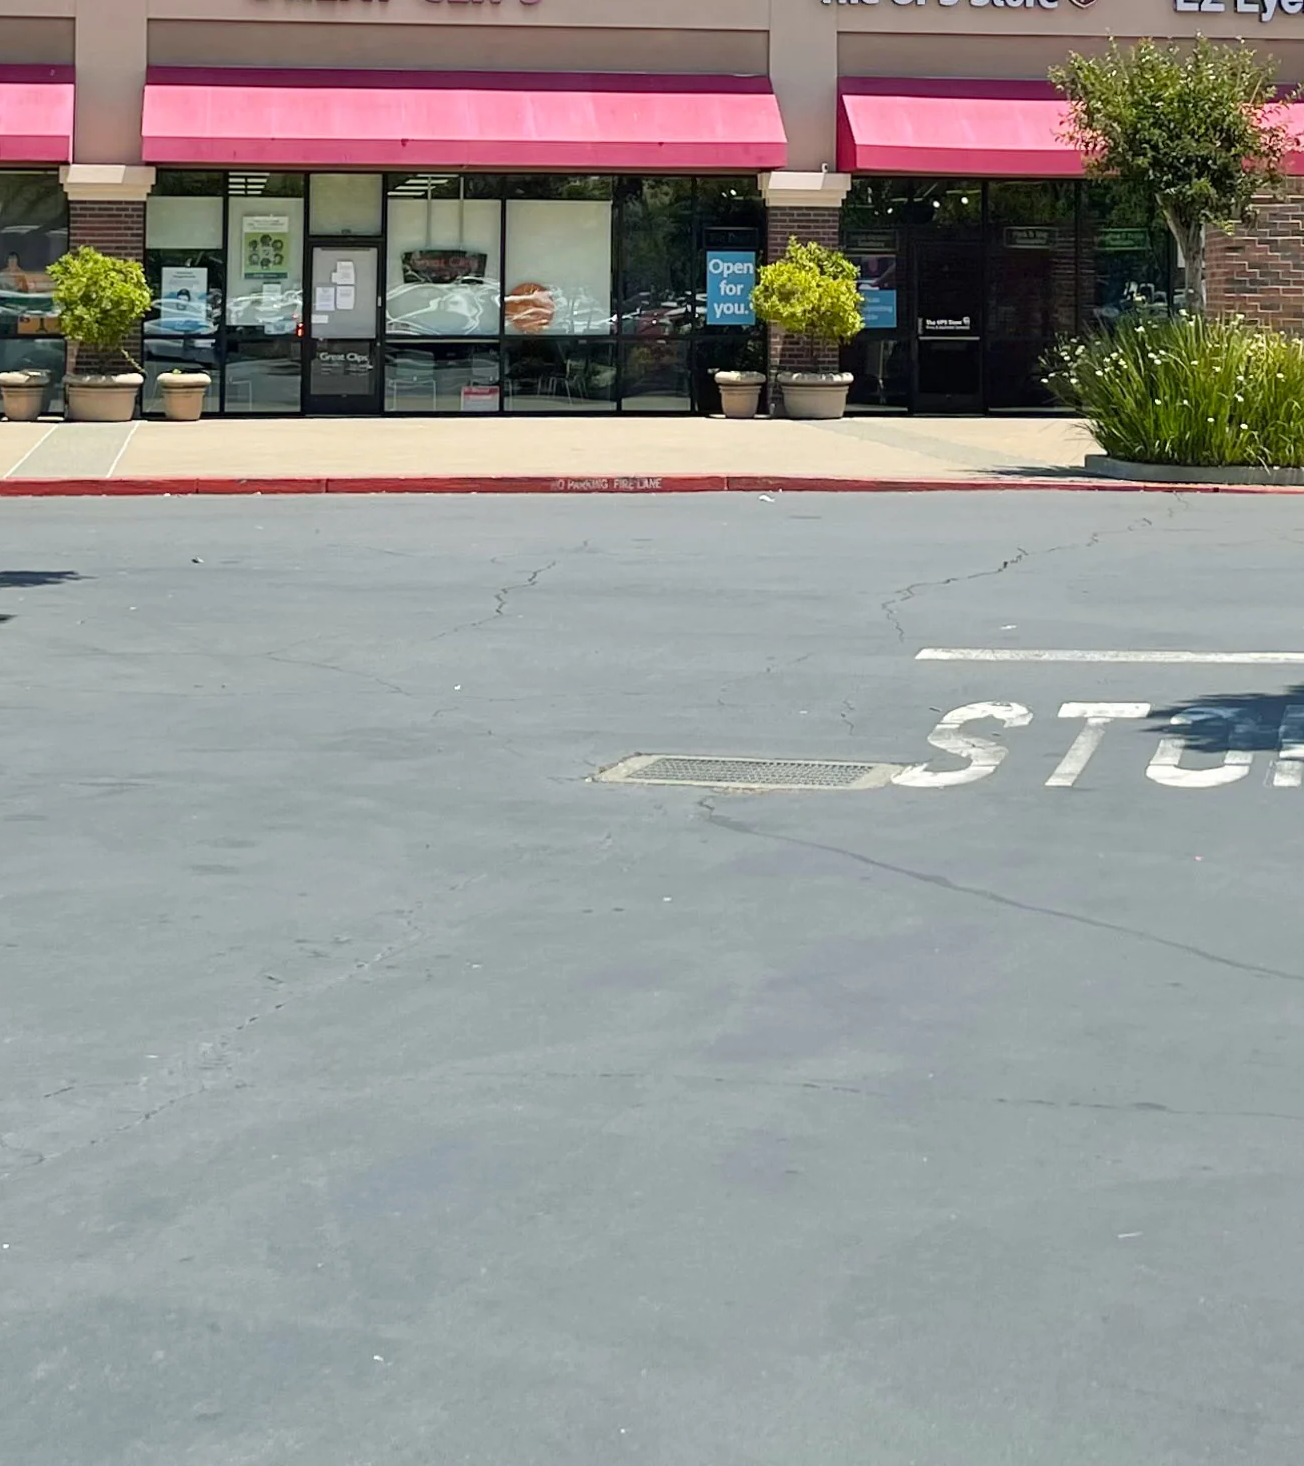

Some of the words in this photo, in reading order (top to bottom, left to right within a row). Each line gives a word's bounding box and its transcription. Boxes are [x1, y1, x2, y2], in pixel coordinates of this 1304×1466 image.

[708, 258, 754, 277] Open
[719, 279, 744, 296] for
[713, 302, 750, 318] you.
